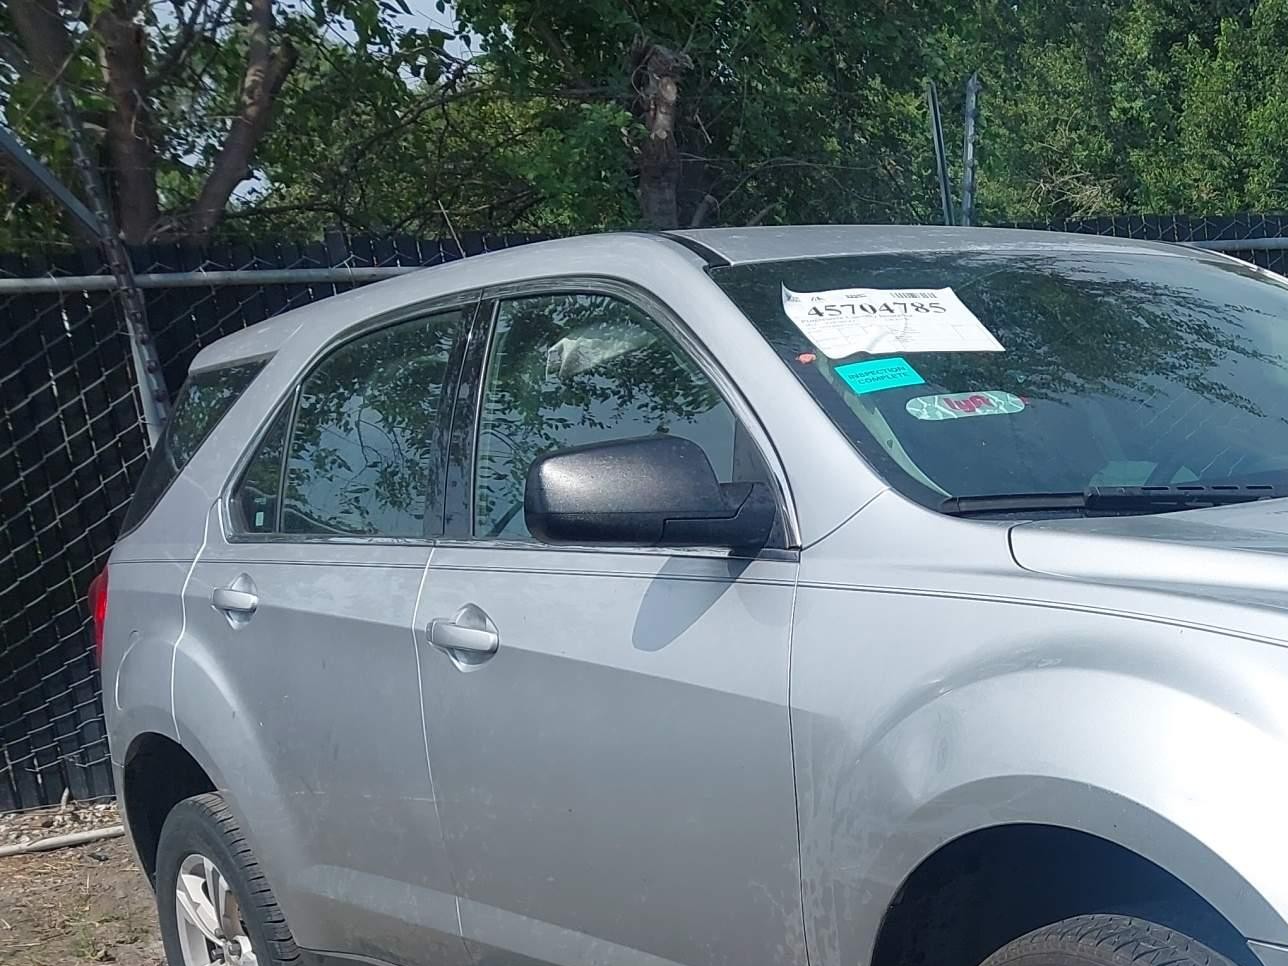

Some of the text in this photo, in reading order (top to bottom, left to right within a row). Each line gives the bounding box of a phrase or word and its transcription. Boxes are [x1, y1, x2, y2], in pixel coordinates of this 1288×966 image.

[807, 301, 947, 317] 45704785
[847, 366, 907, 380] INSPECTION
[858, 372, 911, 385] COMPLETE
